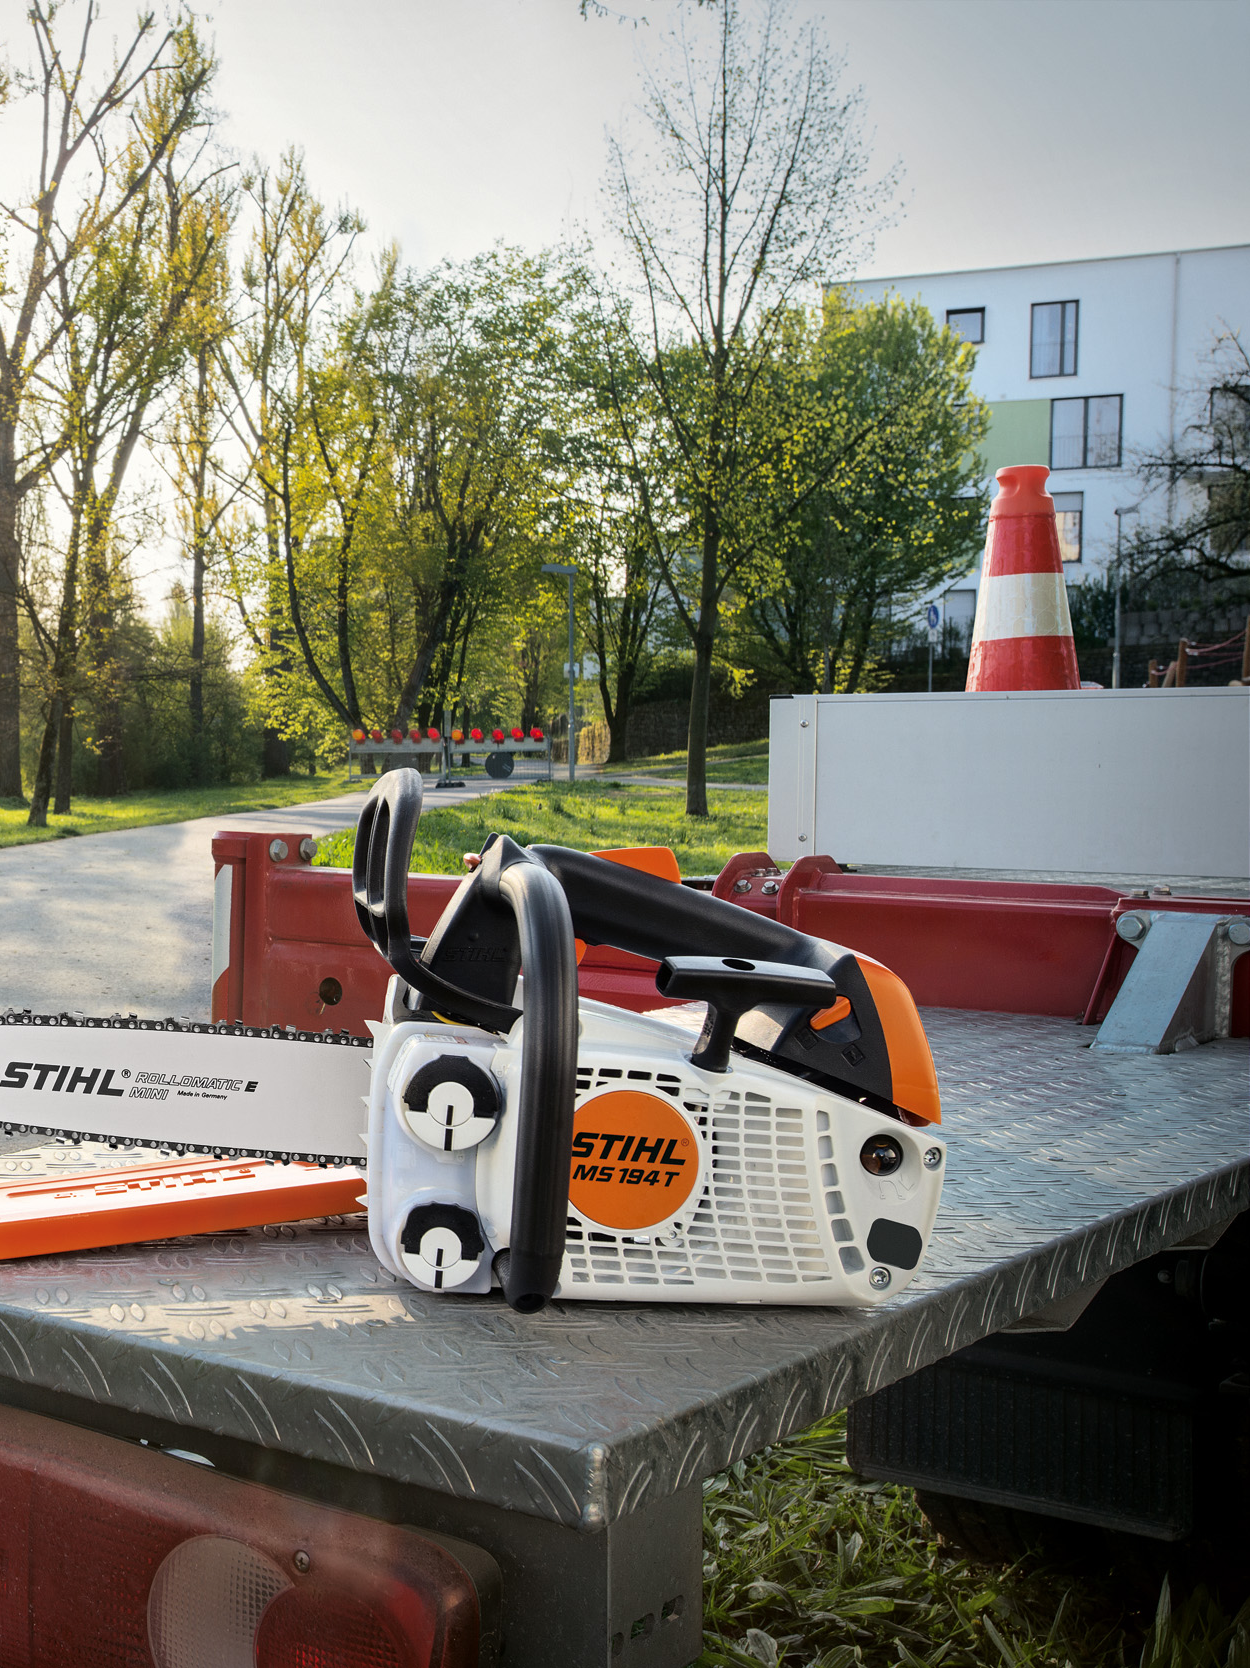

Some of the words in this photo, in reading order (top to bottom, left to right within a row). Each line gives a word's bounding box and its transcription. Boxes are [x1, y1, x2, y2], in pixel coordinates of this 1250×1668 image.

[135, 1071, 243, 1092] ROLLOMATIC
[244, 1081, 258, 1093] E
[129, 1087, 169, 1100] MINI
[201, 1092, 227, 1100] Germany
[572, 1164, 615, 1183] MS
[618, 1168, 660, 1186] 194
[664, 1171, 680, 1187] T
